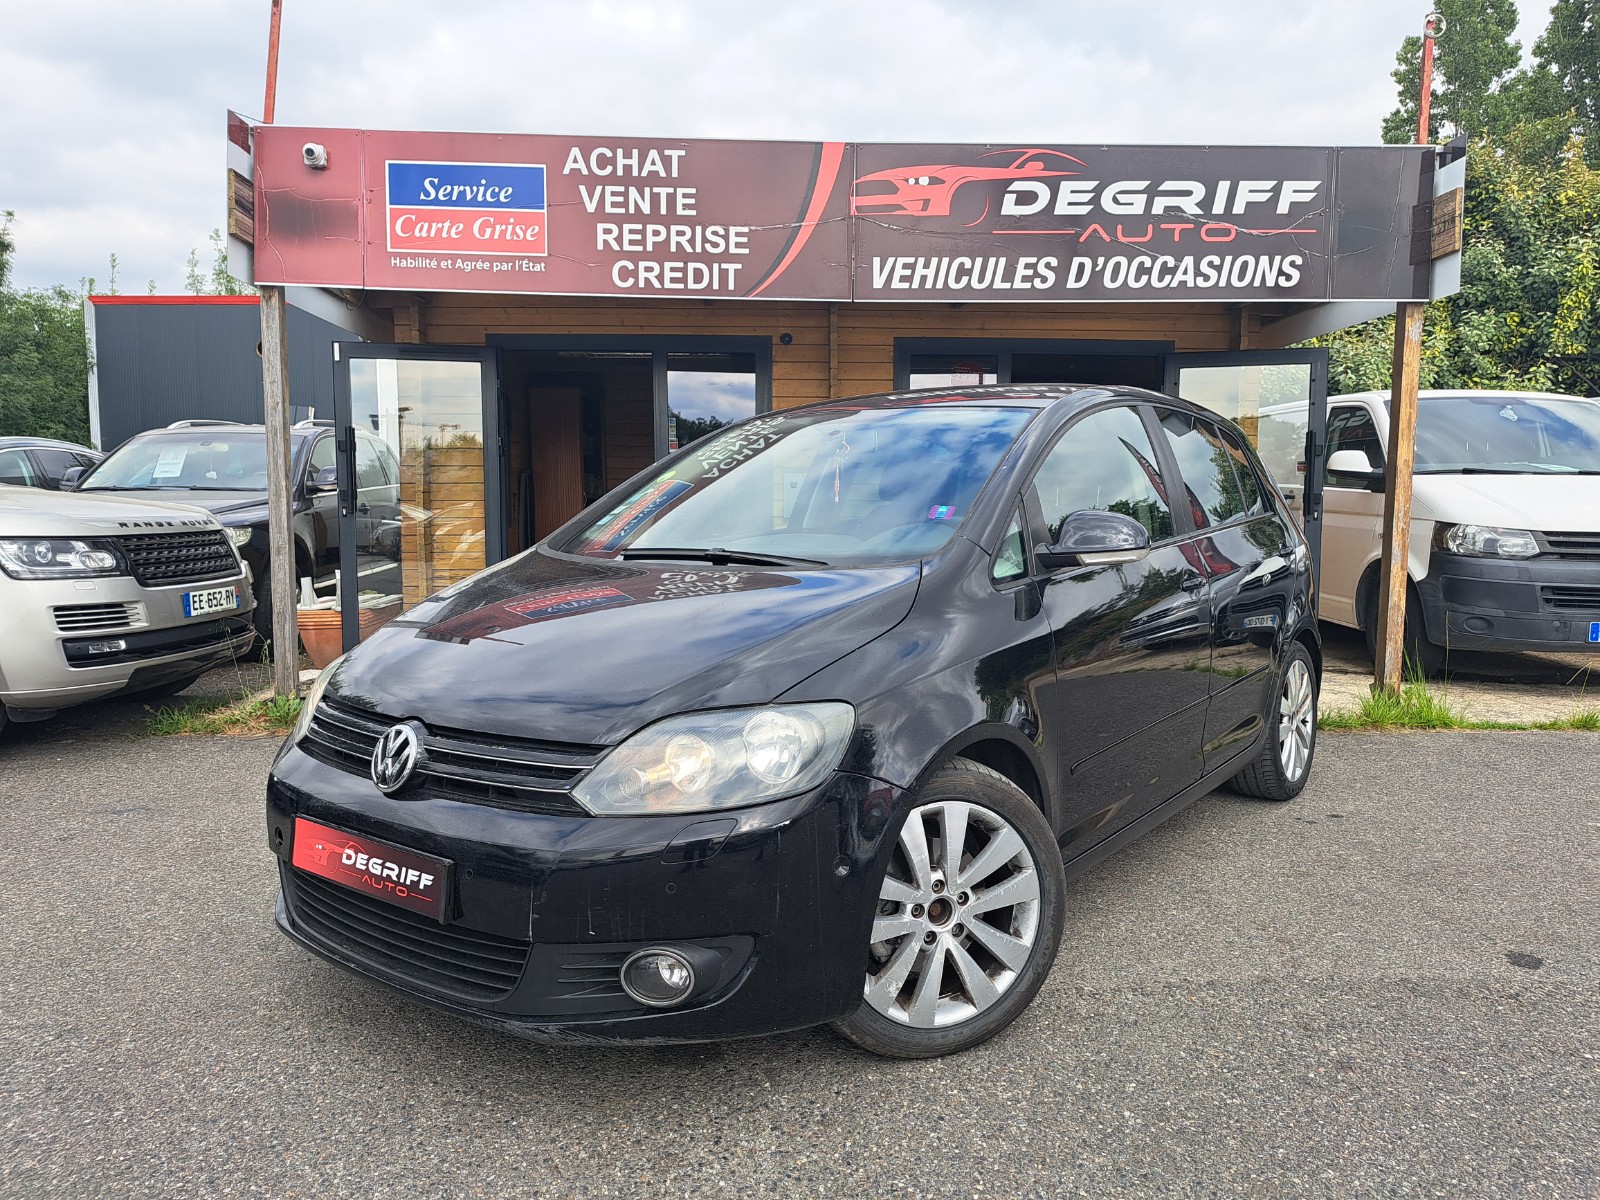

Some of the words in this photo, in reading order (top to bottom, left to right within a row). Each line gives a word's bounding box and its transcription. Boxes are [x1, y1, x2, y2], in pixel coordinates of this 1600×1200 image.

[562, 146, 686, 178] ACHAT
[420, 177, 513, 202] Service
[578, 185, 697, 216] VENTE
[1000, 180, 1323, 216] DEGRIFF
[395, 214, 464, 239] Carte
[472, 216, 540, 241] Grise
[596, 222, 750, 255] REPRISE
[1079, 223, 1238, 243] AUTO
[390, 256, 437, 269] Habilité
[440, 259, 452, 269] et
[455, 258, 491, 272] Agrée
[493, 262, 512, 273] par
[515, 259, 546, 272] l'État
[611, 259, 743, 291] CREDIT
[872, 256, 1059, 290] VEHICULES
[1066, 255, 1303, 290] D'OCCASIONS
[117, 521, 175, 529] RANGE
[180, 519, 215, 527] ROVER
[342, 848, 435, 890] DEGRIFF
[361, 874, 408, 897] AUTO
